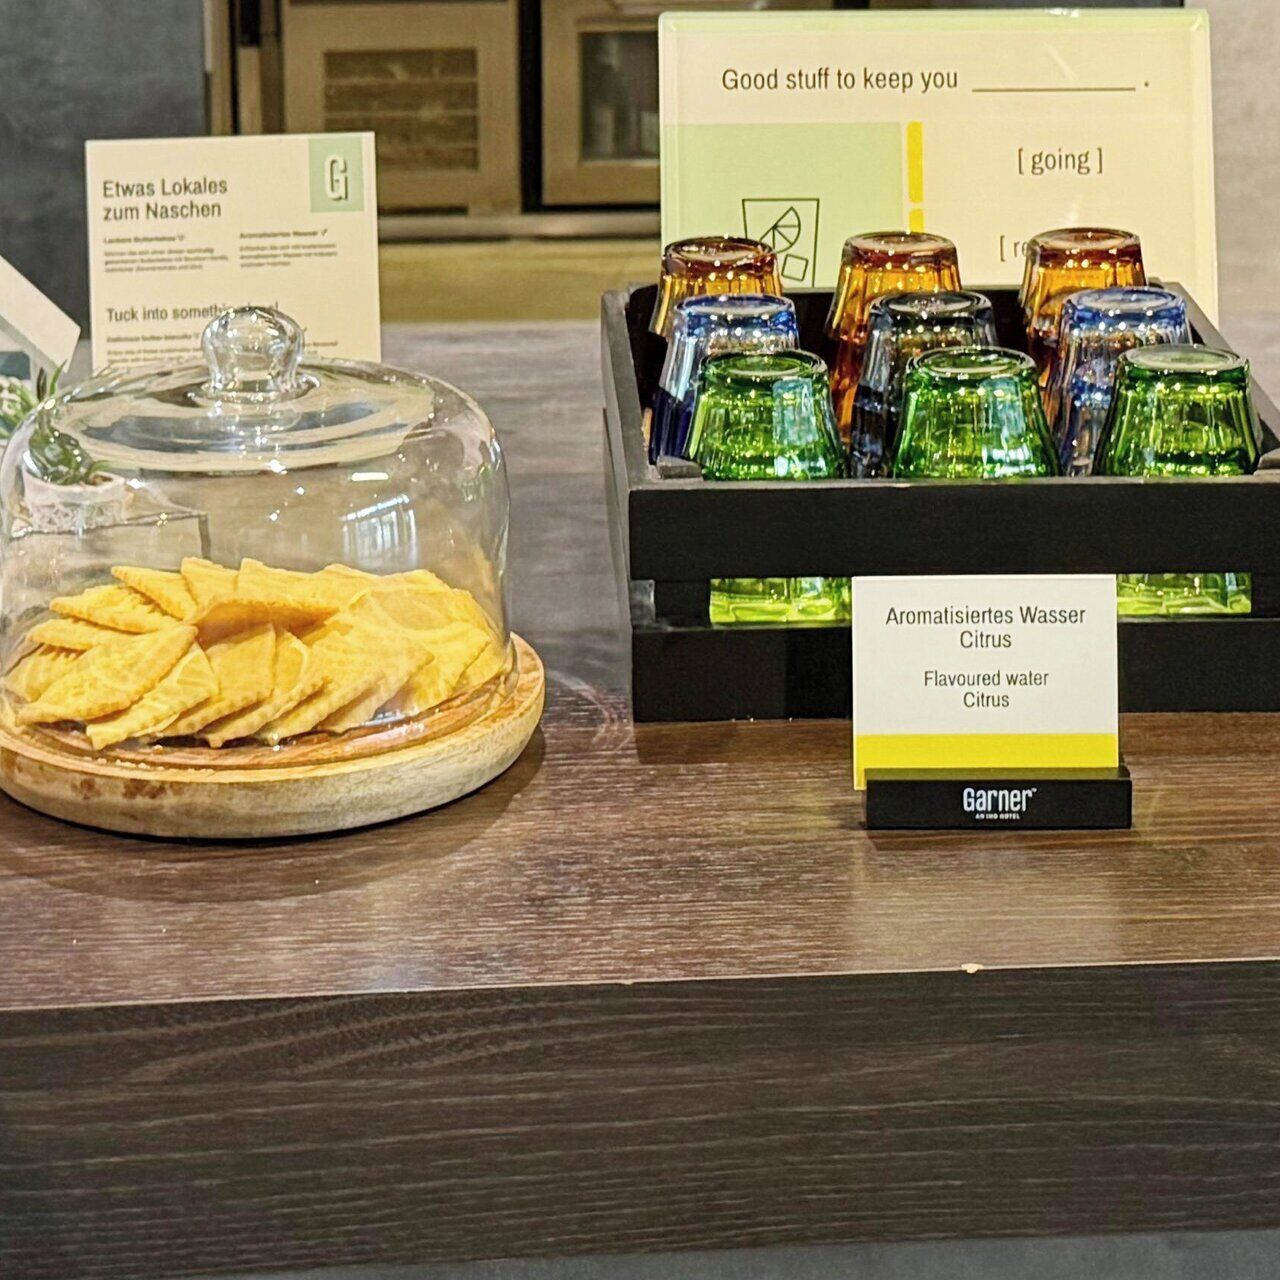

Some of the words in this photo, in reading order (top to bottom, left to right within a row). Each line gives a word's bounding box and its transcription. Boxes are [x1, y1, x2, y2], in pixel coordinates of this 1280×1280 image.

[721, 68, 779, 92] Good
[785, 67, 830, 92] stuff
[835, 70, 856, 91] to
[862, 67, 915, 96] keep
[920, 72, 959, 96] you
[1030, 147, 1090, 176] going
[102, 179, 155, 199] Etwas
[161, 176, 228, 197] Lokales
[103, 205, 140, 221] zum
[145, 201, 222, 220] Naschen
[106, 306, 137, 323] Tuck
[142, 306, 168, 322] into
[885, 605, 1014, 626] Aromatisiertes
[1019, 605, 1086, 624] Wasser
[959, 629, 1012, 649] Citrus
[924, 670, 1001, 687] Flavoured
[1006, 670, 1049, 686] water
[963, 691, 1010, 709] Citrus
[963, 787, 1033, 812] Garner
